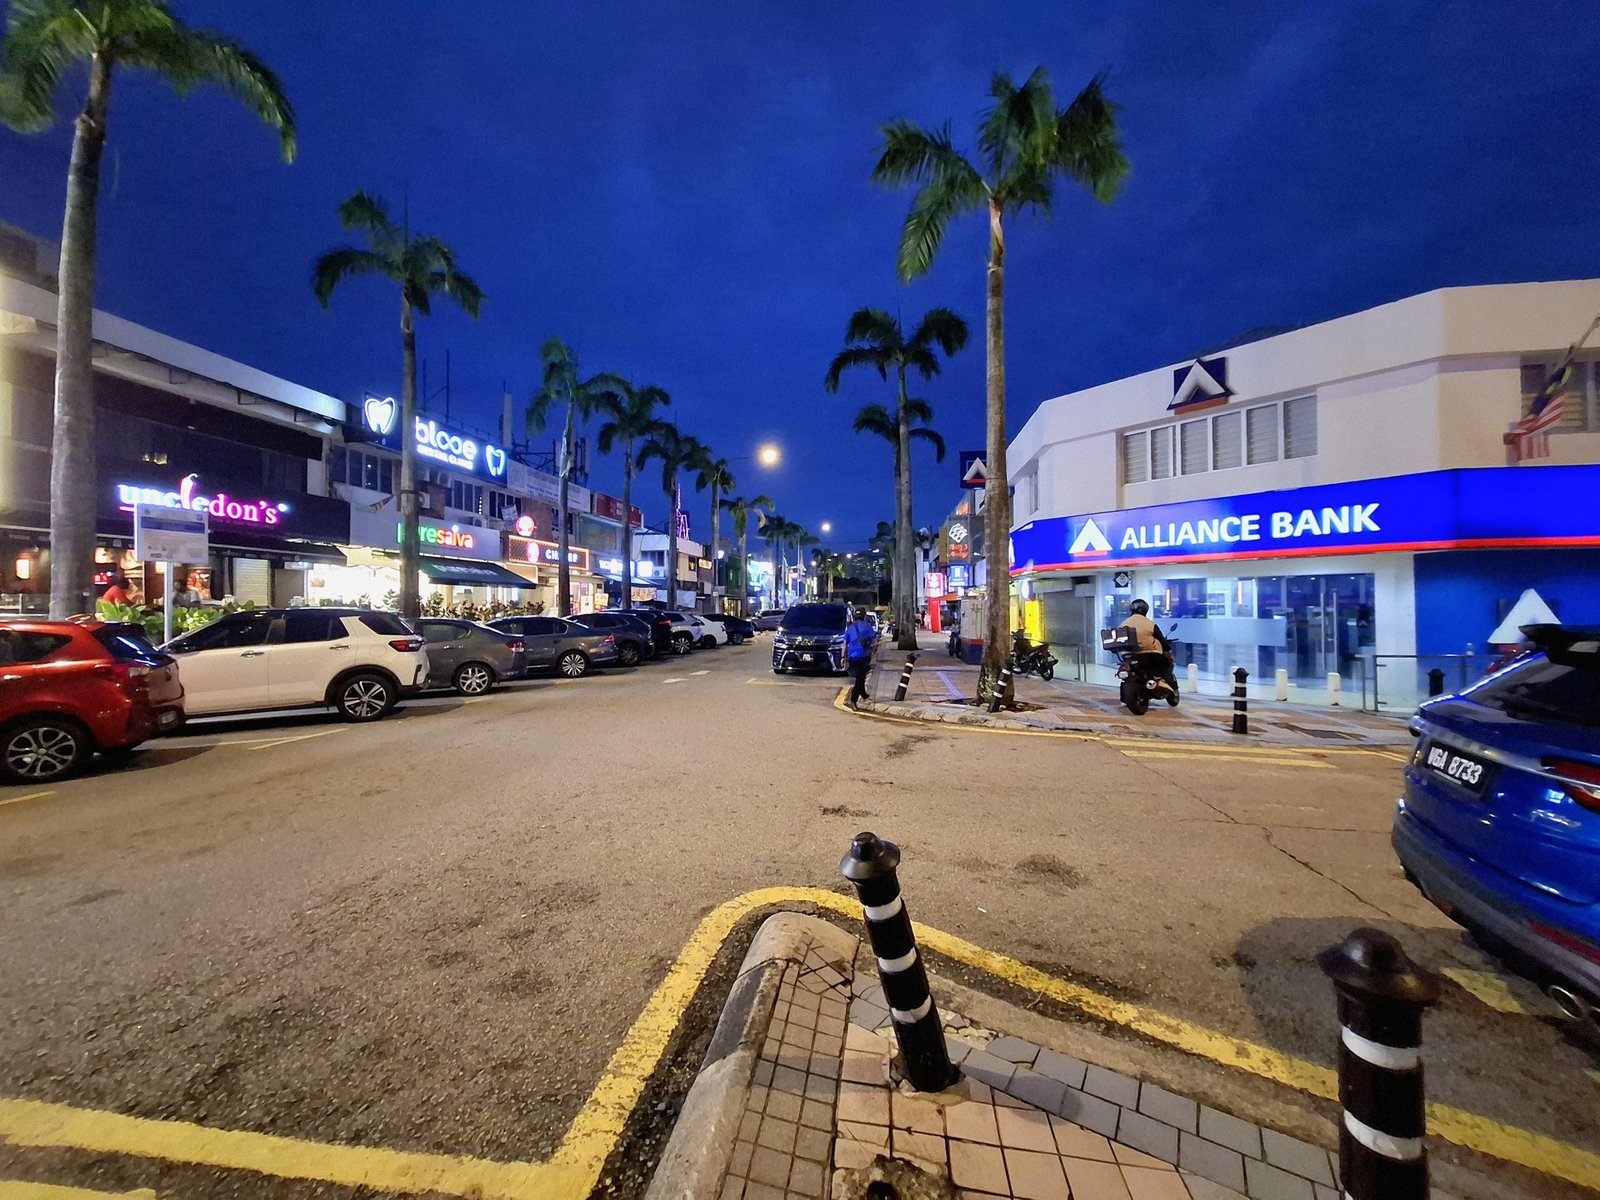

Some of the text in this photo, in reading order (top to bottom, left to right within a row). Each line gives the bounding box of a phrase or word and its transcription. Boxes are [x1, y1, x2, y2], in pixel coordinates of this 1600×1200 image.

[1120, 503, 1381, 550] ALLIANCE BANK
[1447, 756, 1483, 784] 8733
